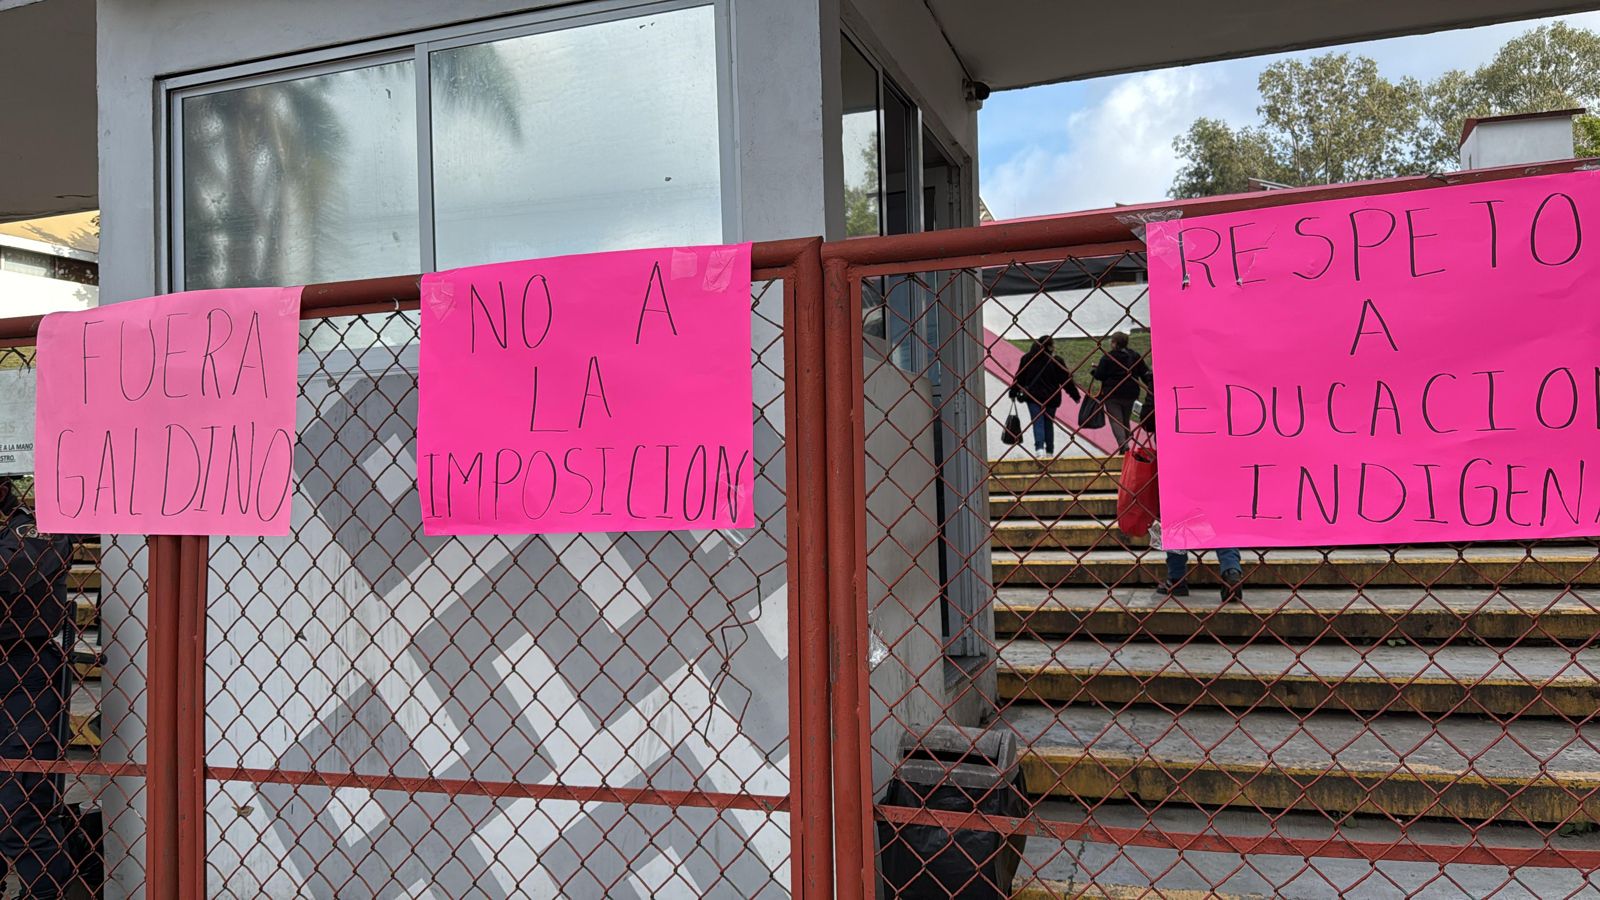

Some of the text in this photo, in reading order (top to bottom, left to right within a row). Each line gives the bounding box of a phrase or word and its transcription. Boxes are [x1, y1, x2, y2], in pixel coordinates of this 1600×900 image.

[1178, 192, 1582, 290] RESPETO
[470, 261, 678, 353] NO A
[1349, 298, 1399, 356] A
[82, 307, 268, 405] FUERA
[530, 356, 612, 432] LA
[1172, 366, 1600, 438] EDUCACIO
[56, 421, 293, 522] GALDINO
[423, 445, 750, 524] IMPOSICION
[1235, 457, 1600, 527] INDIGEN
